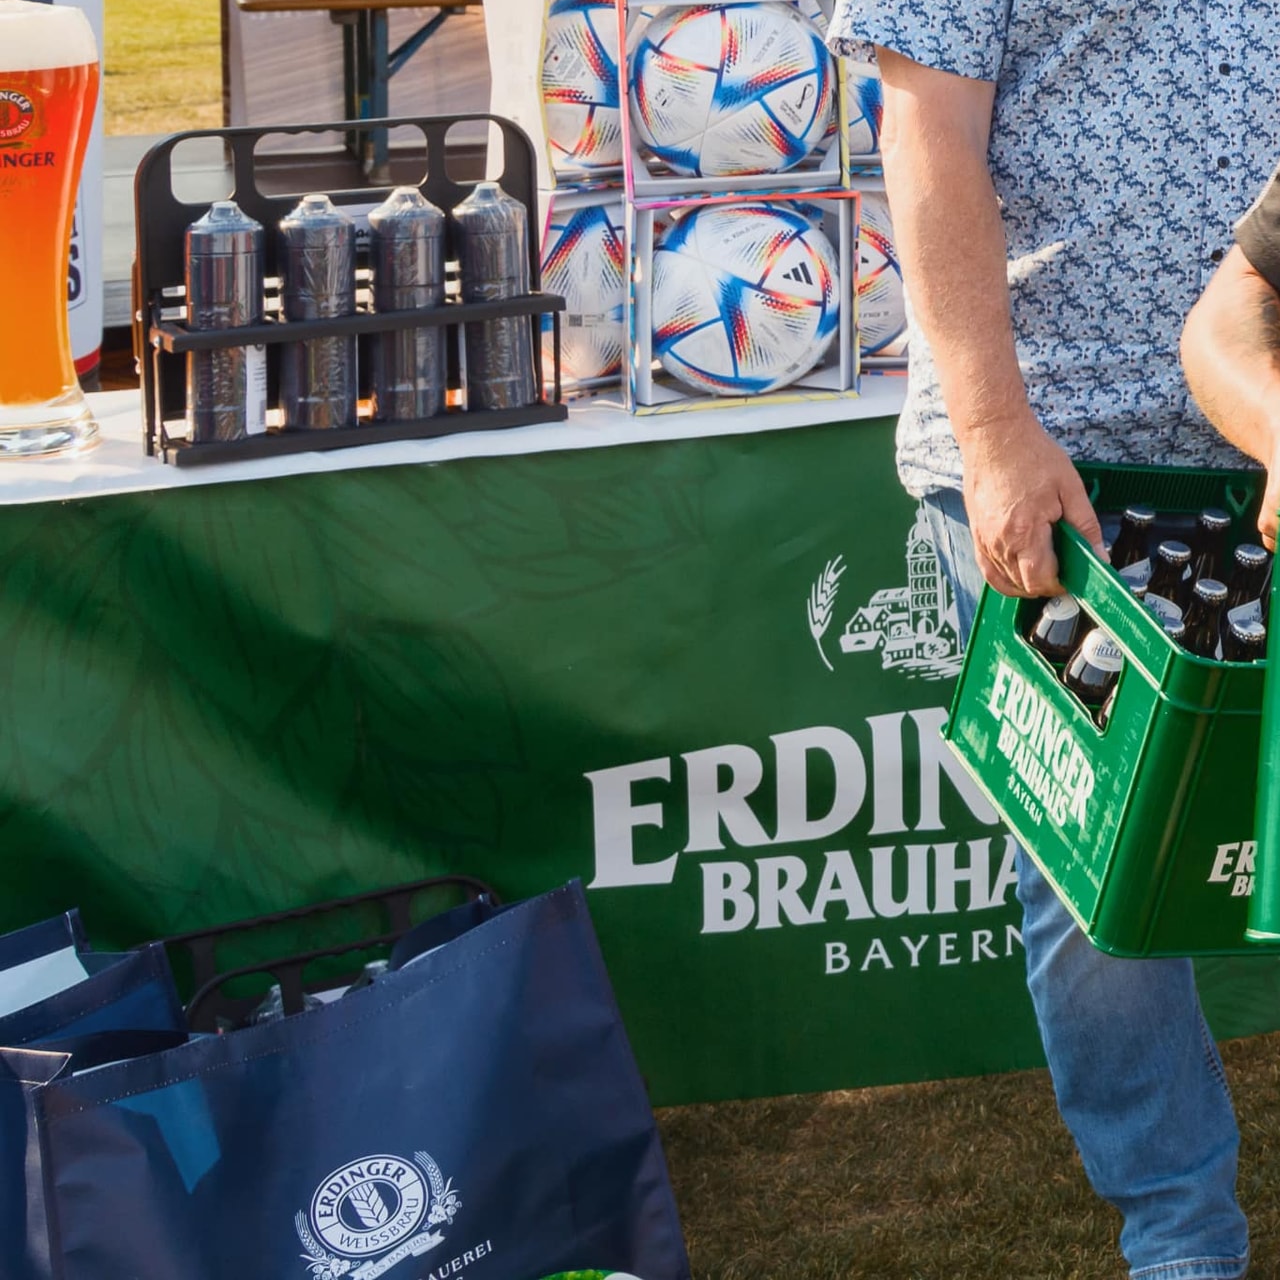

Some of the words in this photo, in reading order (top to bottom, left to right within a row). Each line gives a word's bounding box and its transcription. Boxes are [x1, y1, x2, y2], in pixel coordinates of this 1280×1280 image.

[987, 660, 1095, 830] ERDINGER
[996, 716, 1069, 828] BRAUHAUS
[317, 1161, 407, 1219] ERDINGER
